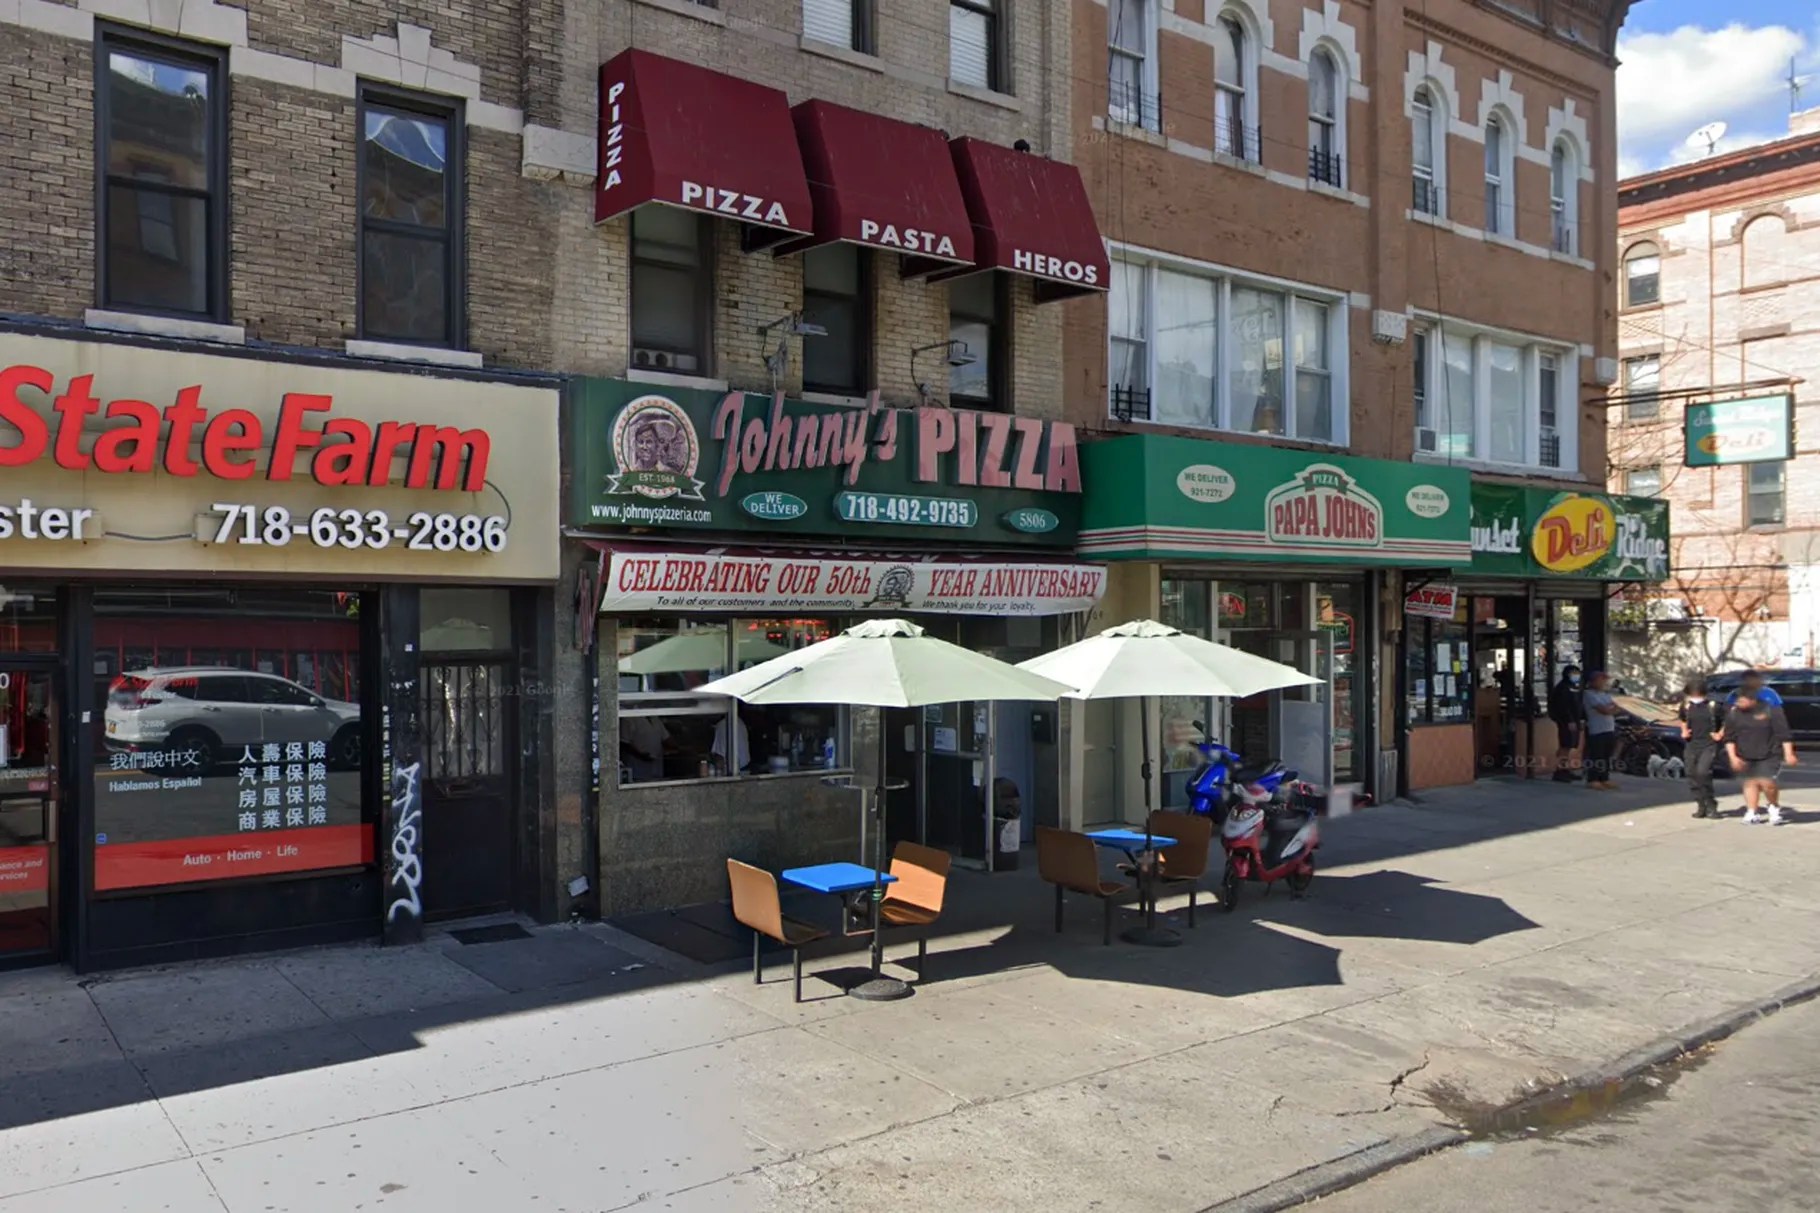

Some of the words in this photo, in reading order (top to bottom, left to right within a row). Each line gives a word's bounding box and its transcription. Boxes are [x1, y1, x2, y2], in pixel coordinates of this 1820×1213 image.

[604, 81, 625, 191] PIZZA
[681, 180, 789, 226] PIZZA
[861, 219, 957, 257] PASTA
[1013, 248, 1098, 284] HEROS
[710, 389, 898, 497] Johnny's
[912, 406, 1083, 493] PIZZA
[1184, 472, 1196, 482] WE
[1197, 474, 1228, 484] DELIVER
[1312, 473, 1339, 487] PIZZA
[750, 502, 800, 515] DELIVER
[765, 493, 782, 504] WE
[847, 495, 969, 525] 718-492-9735
[591, 503, 712, 524] www.johnnyspizzeria.com
[1019, 511, 1046, 528] 5806
[1274, 494, 1320, 536] PAPA
[211, 503, 508, 553] 718-633-2886
[1541, 507, 1609, 564] Deli
[618, 557, 772, 593] CELEBRATING
[777, 562, 821, 595] OUR
[826, 564, 872, 596] 50th
[927, 568, 976, 598] YEAR
[978, 568, 1102, 599] ANNIVERSARY
[657, 596, 669, 606] To
[671, 596, 684, 606] all
[686, 596, 699, 606] of
[717, 598, 765, 607] customers
[769, 599, 788, 607] and
[789, 599, 804, 607] the
[922, 600, 935, 609] We
[935, 600, 958, 610] thank
[959, 602, 975, 612] you
[976, 601, 988, 610] for
[110, 749, 200, 770] 我們說中文
[109, 779, 160, 792] Hablamos
[162, 777, 202, 791] Español
[238, 762, 327, 786] 汽車保險
[238, 784, 327, 808] 房屋保險
[238, 805, 327, 831] 商業保險
[183, 854, 212, 865] Auto
[226, 850, 262, 862] Home
[277, 846, 298, 857] Life
